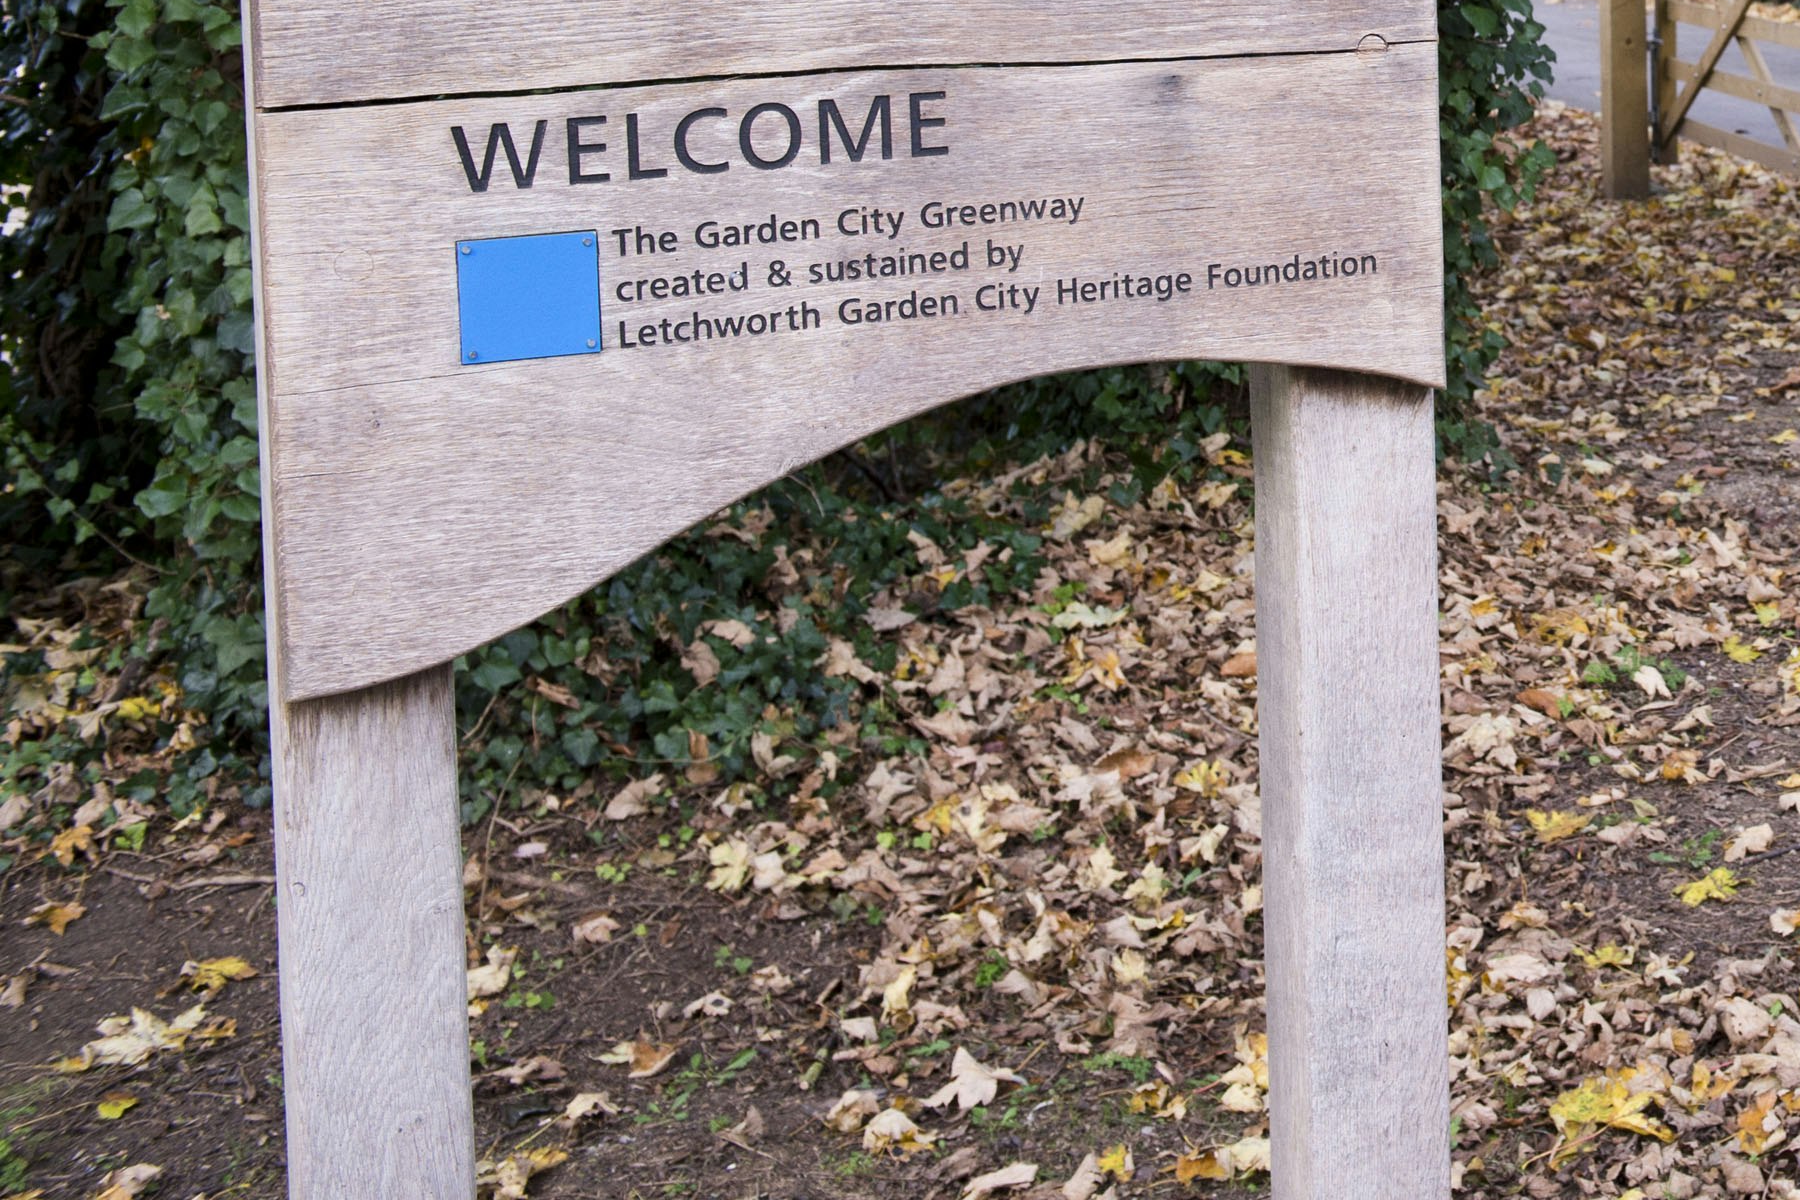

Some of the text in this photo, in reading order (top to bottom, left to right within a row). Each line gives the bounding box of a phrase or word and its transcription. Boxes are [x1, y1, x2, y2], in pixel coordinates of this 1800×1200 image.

[451, 90, 950, 193] WELCOME
[612, 196, 1084, 257] The Garden City Greenway
[616, 239, 1024, 302] created & sustained by
[619, 251, 1378, 349] Letchworth Garden City Heritage Foundation
